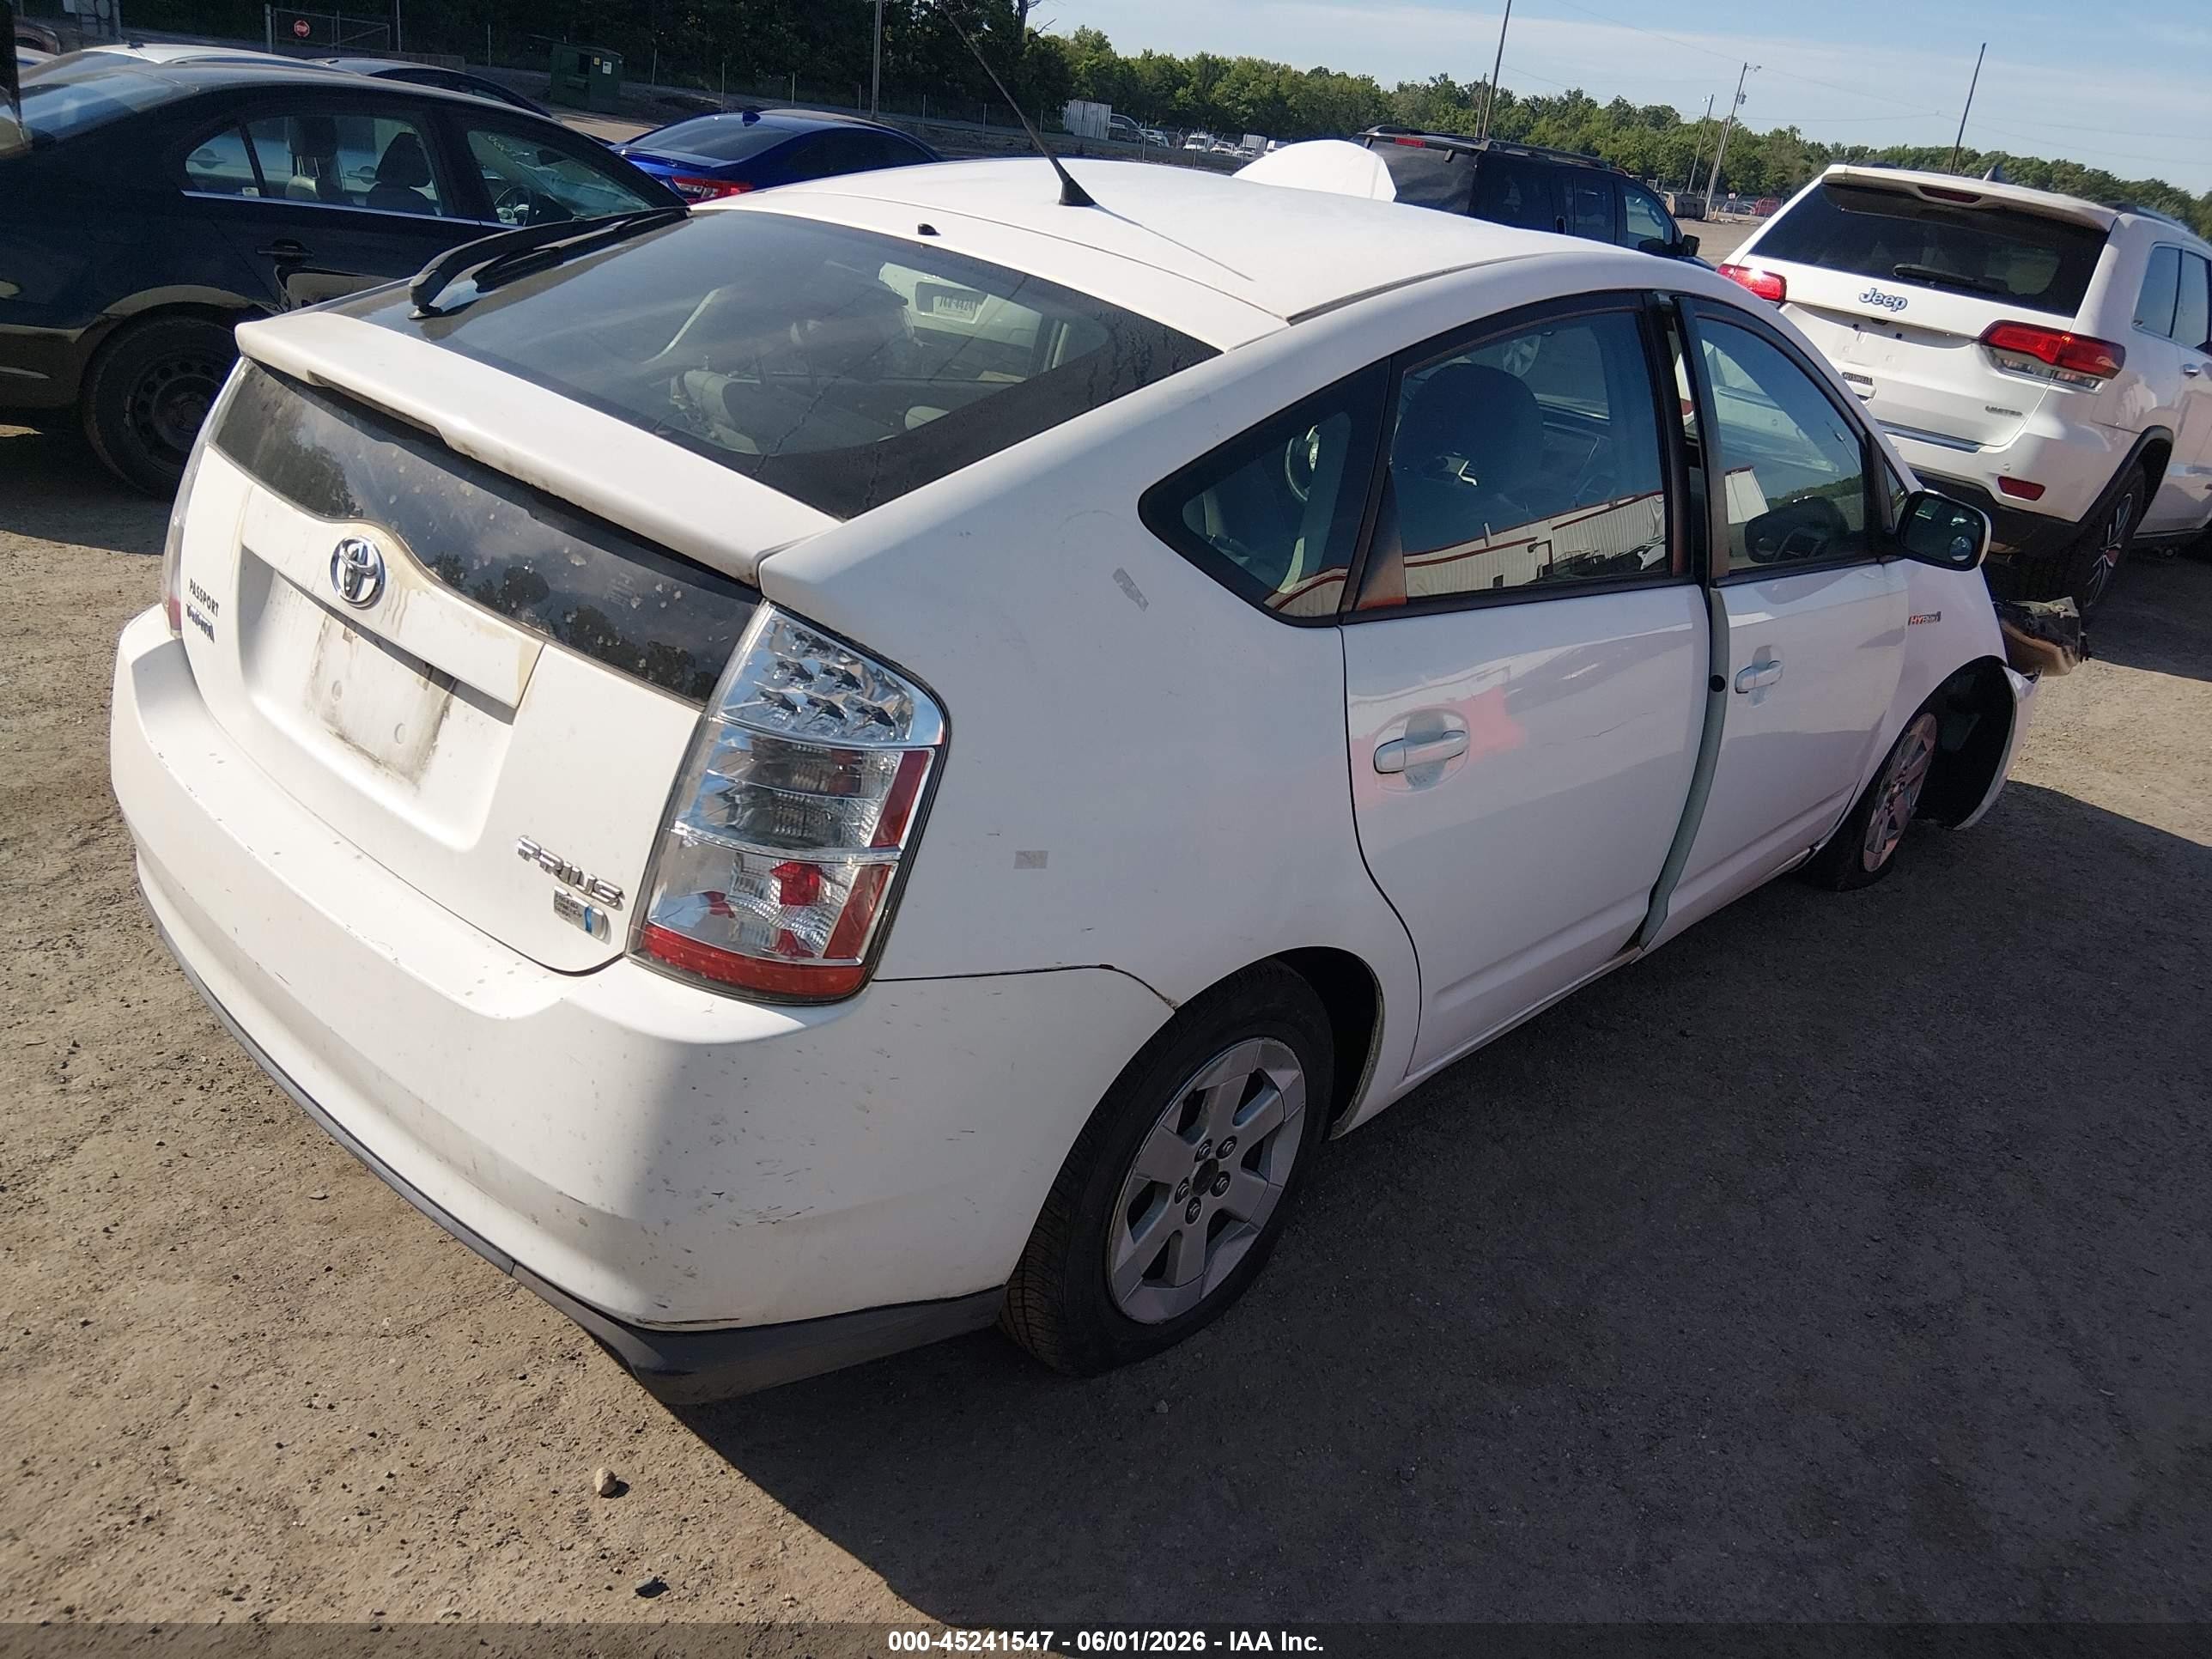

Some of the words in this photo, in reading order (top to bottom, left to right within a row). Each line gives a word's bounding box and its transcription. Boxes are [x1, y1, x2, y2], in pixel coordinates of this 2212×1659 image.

[1859, 288, 1908, 312] Jeep
[189, 577, 219, 617] PASSPORT
[517, 835, 624, 910] PRIUS
